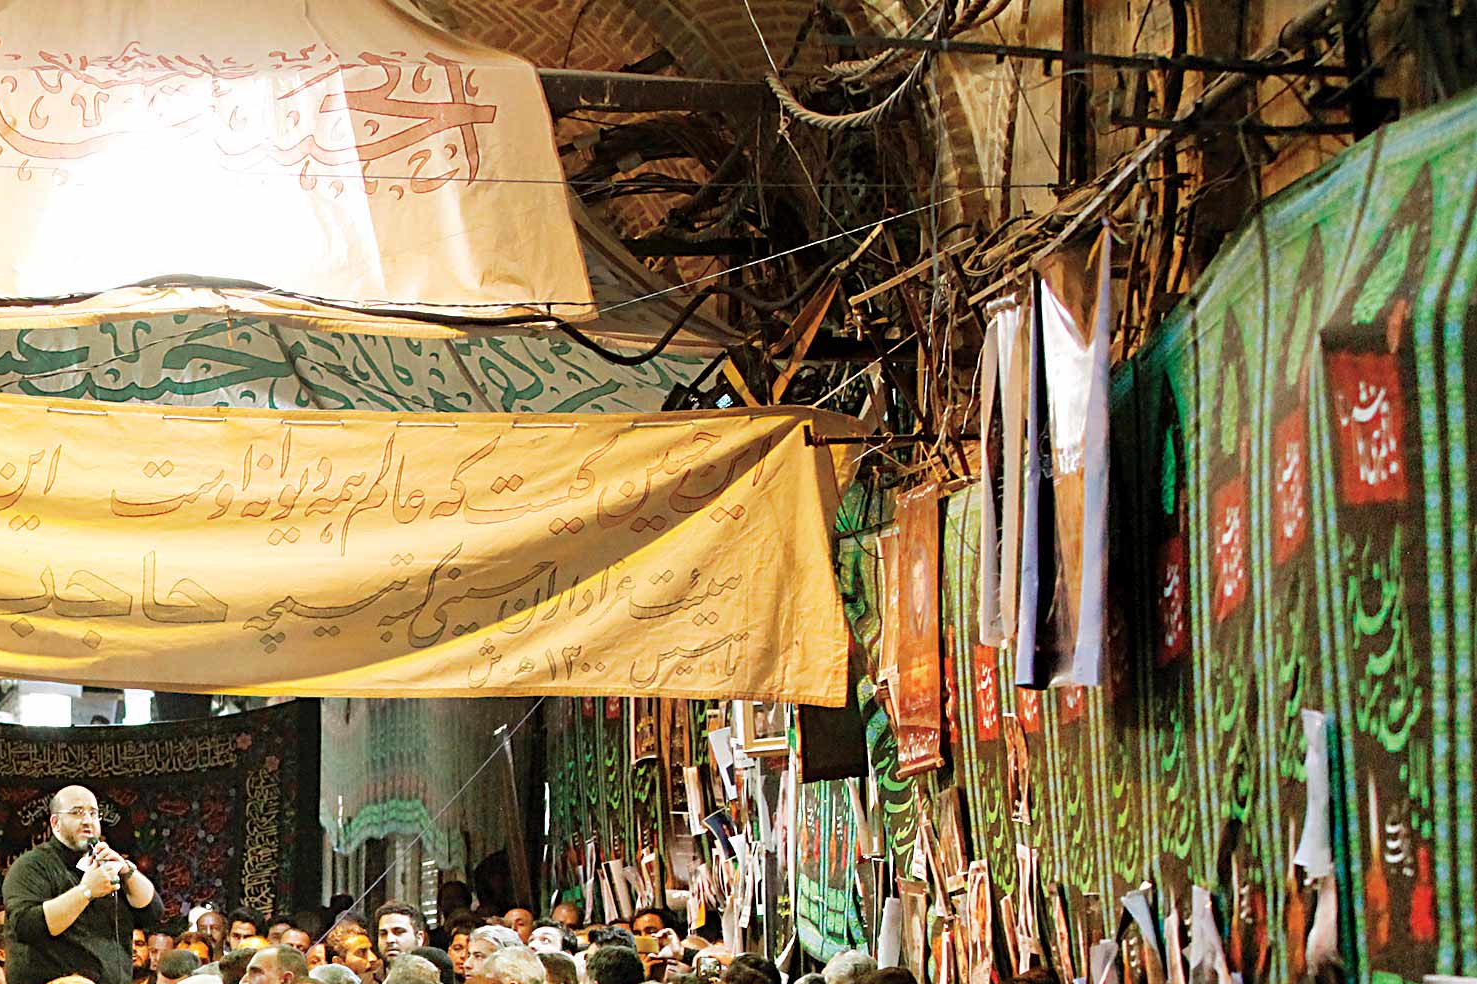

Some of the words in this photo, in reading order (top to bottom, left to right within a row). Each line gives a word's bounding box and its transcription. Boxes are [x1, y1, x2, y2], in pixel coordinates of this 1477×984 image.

[111, 443, 254, 521] اوست
[241, 426, 333, 546] دیوانه
[304, 471, 367, 544] همه
[341, 431, 426, 557] عالم
[429, 434, 501, 520] که
[464, 434, 619, 535] کیست
[596, 431, 722, 533] حسین
[668, 434, 774, 523] این
[242, 553, 414, 654] تیمچه
[377, 542, 464, 644] کسبه
[407, 560, 556, 649] حسینی
[497, 558, 636, 635] عزاداران
